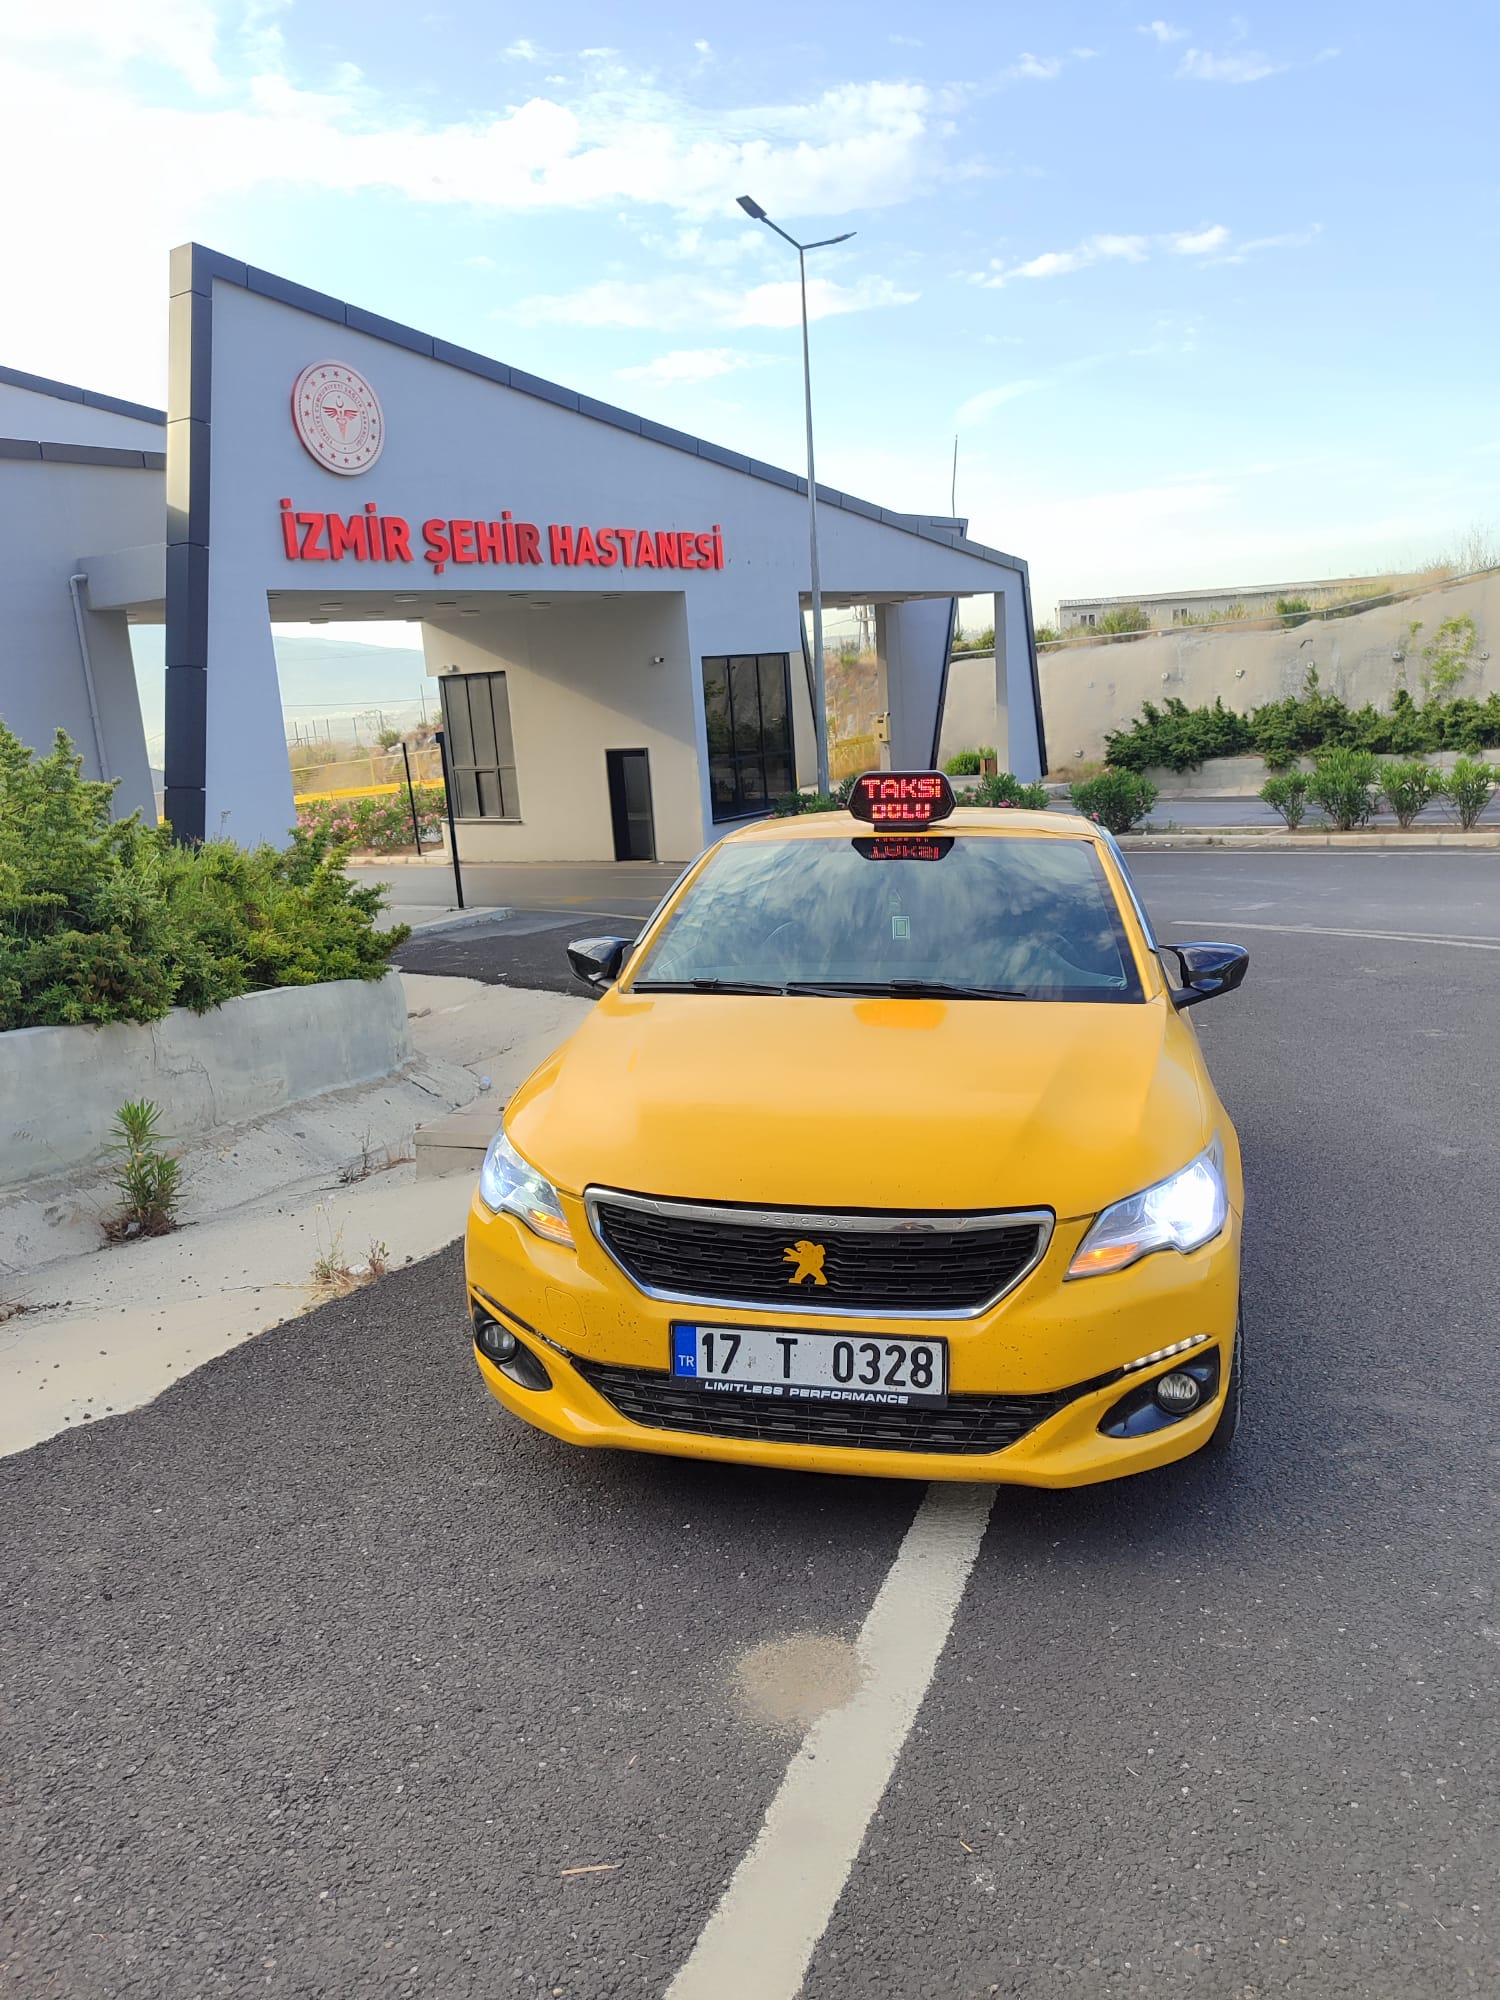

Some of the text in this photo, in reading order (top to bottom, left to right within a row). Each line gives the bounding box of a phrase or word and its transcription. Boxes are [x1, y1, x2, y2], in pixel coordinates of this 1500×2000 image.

[280, 497, 725, 574] İZMİR ŞEHİR HASTANESİ
[872, 803, 931, 819] DOLU
[759, 1214, 853, 1228] PEUGEOT
[678, 1354, 695, 1368] TR
[701, 1332, 934, 1389] 17 T 0328
[704, 1381, 909, 1405] LIMITLESS PERFORMANCE
